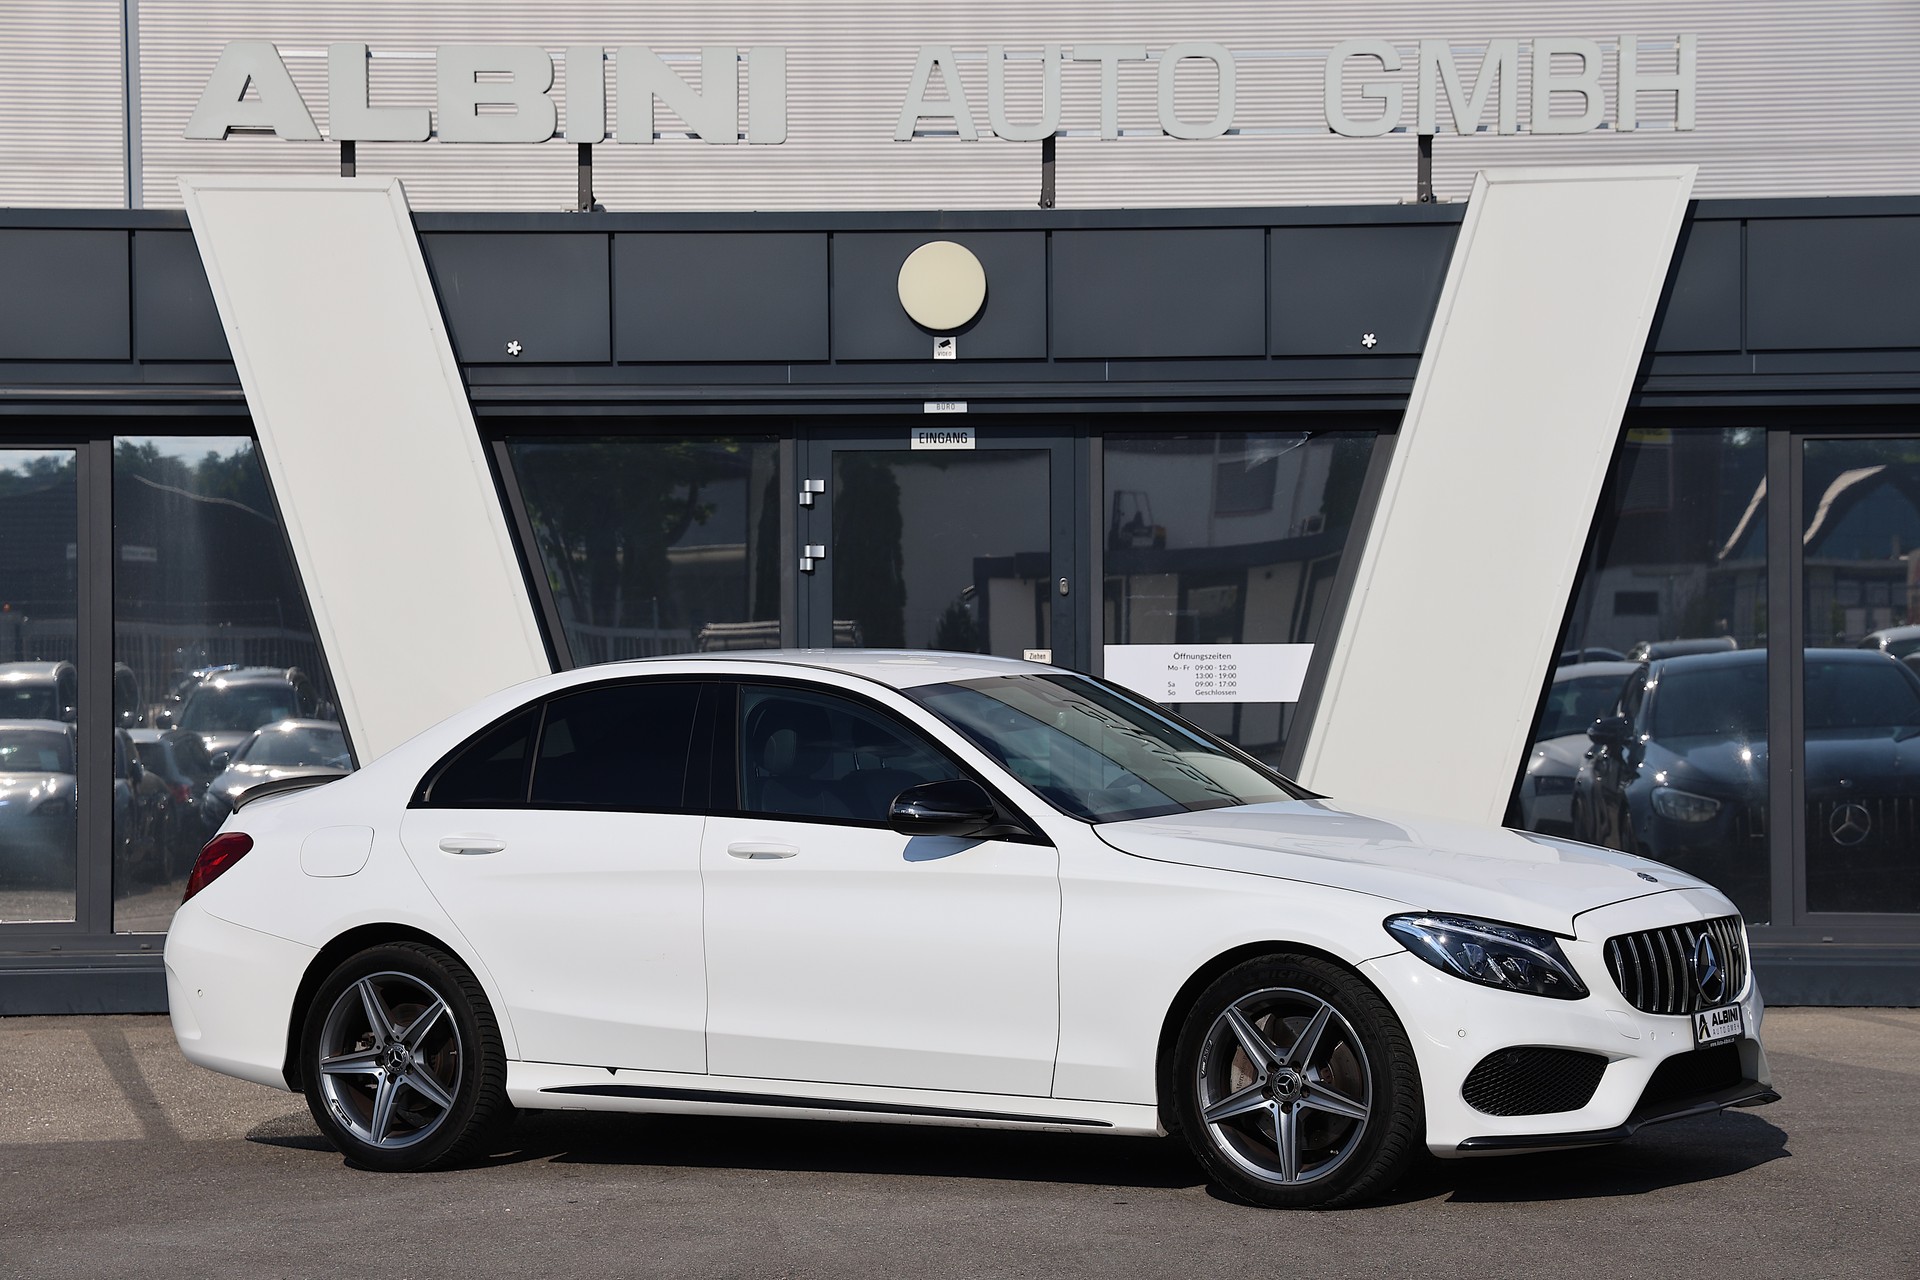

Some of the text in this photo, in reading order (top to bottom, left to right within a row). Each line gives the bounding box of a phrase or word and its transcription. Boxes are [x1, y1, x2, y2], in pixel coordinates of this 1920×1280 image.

[182, 33, 1699, 145] ALBINI AUTO GMBH
[919, 432, 968, 444] EINGANG
[1029, 652, 1047, 660] Ziehen
[1173, 652, 1232, 661] Öffnungszeiten
[1712, 1008, 1738, 1026] ALBINI
